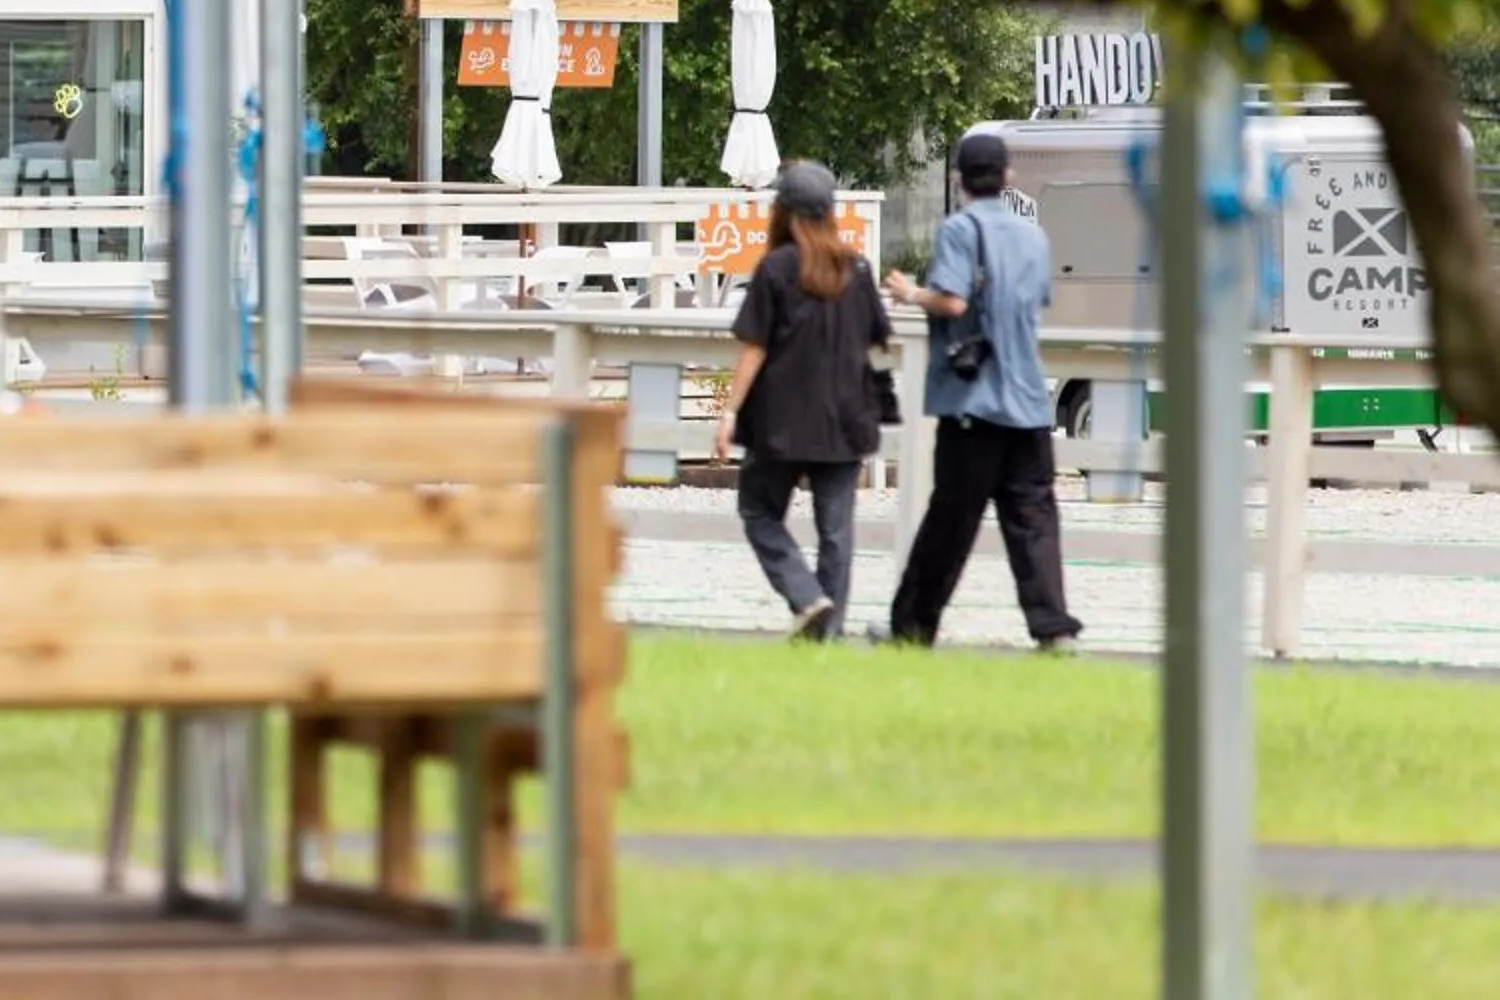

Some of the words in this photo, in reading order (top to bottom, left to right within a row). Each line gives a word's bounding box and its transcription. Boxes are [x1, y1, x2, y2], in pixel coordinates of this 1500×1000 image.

[1307, 177, 1343, 255] FREE
[1353, 172, 1388, 190] AND
[1334, 299, 1408, 311] RESORT
